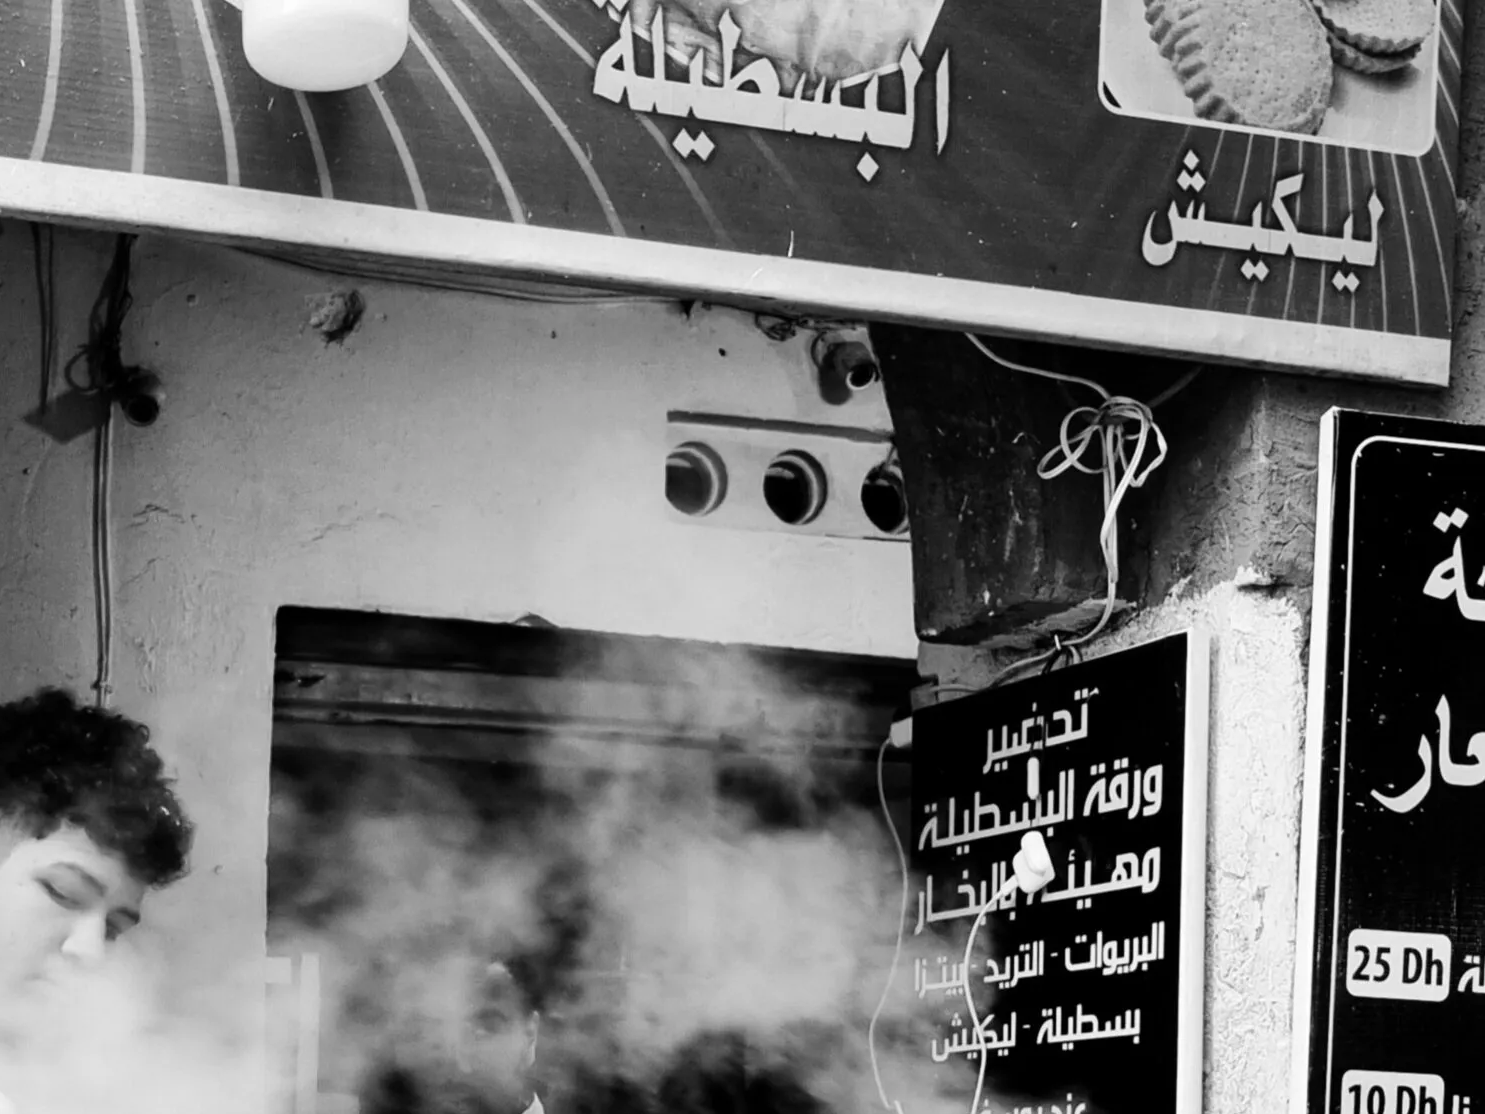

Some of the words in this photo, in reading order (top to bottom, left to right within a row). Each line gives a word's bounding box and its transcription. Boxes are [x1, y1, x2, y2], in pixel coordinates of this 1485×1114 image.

[593, 0, 950, 182] البسطيلة
[1142, 149, 1385, 293] ليكيش
[918, 768, 1075, 855] البسطيلة
[1083, 757, 1163, 820] ورقة
[984, 940, 1045, 989] التريد
[1064, 920, 1165, 976] البريوات
[1352, 945, 1391, 982] 25
[1402, 947, 1444, 986] Dh
[932, 1011, 1016, 1062] ليكيش
[1036, 1003, 1141, 1051] بسطيلة
